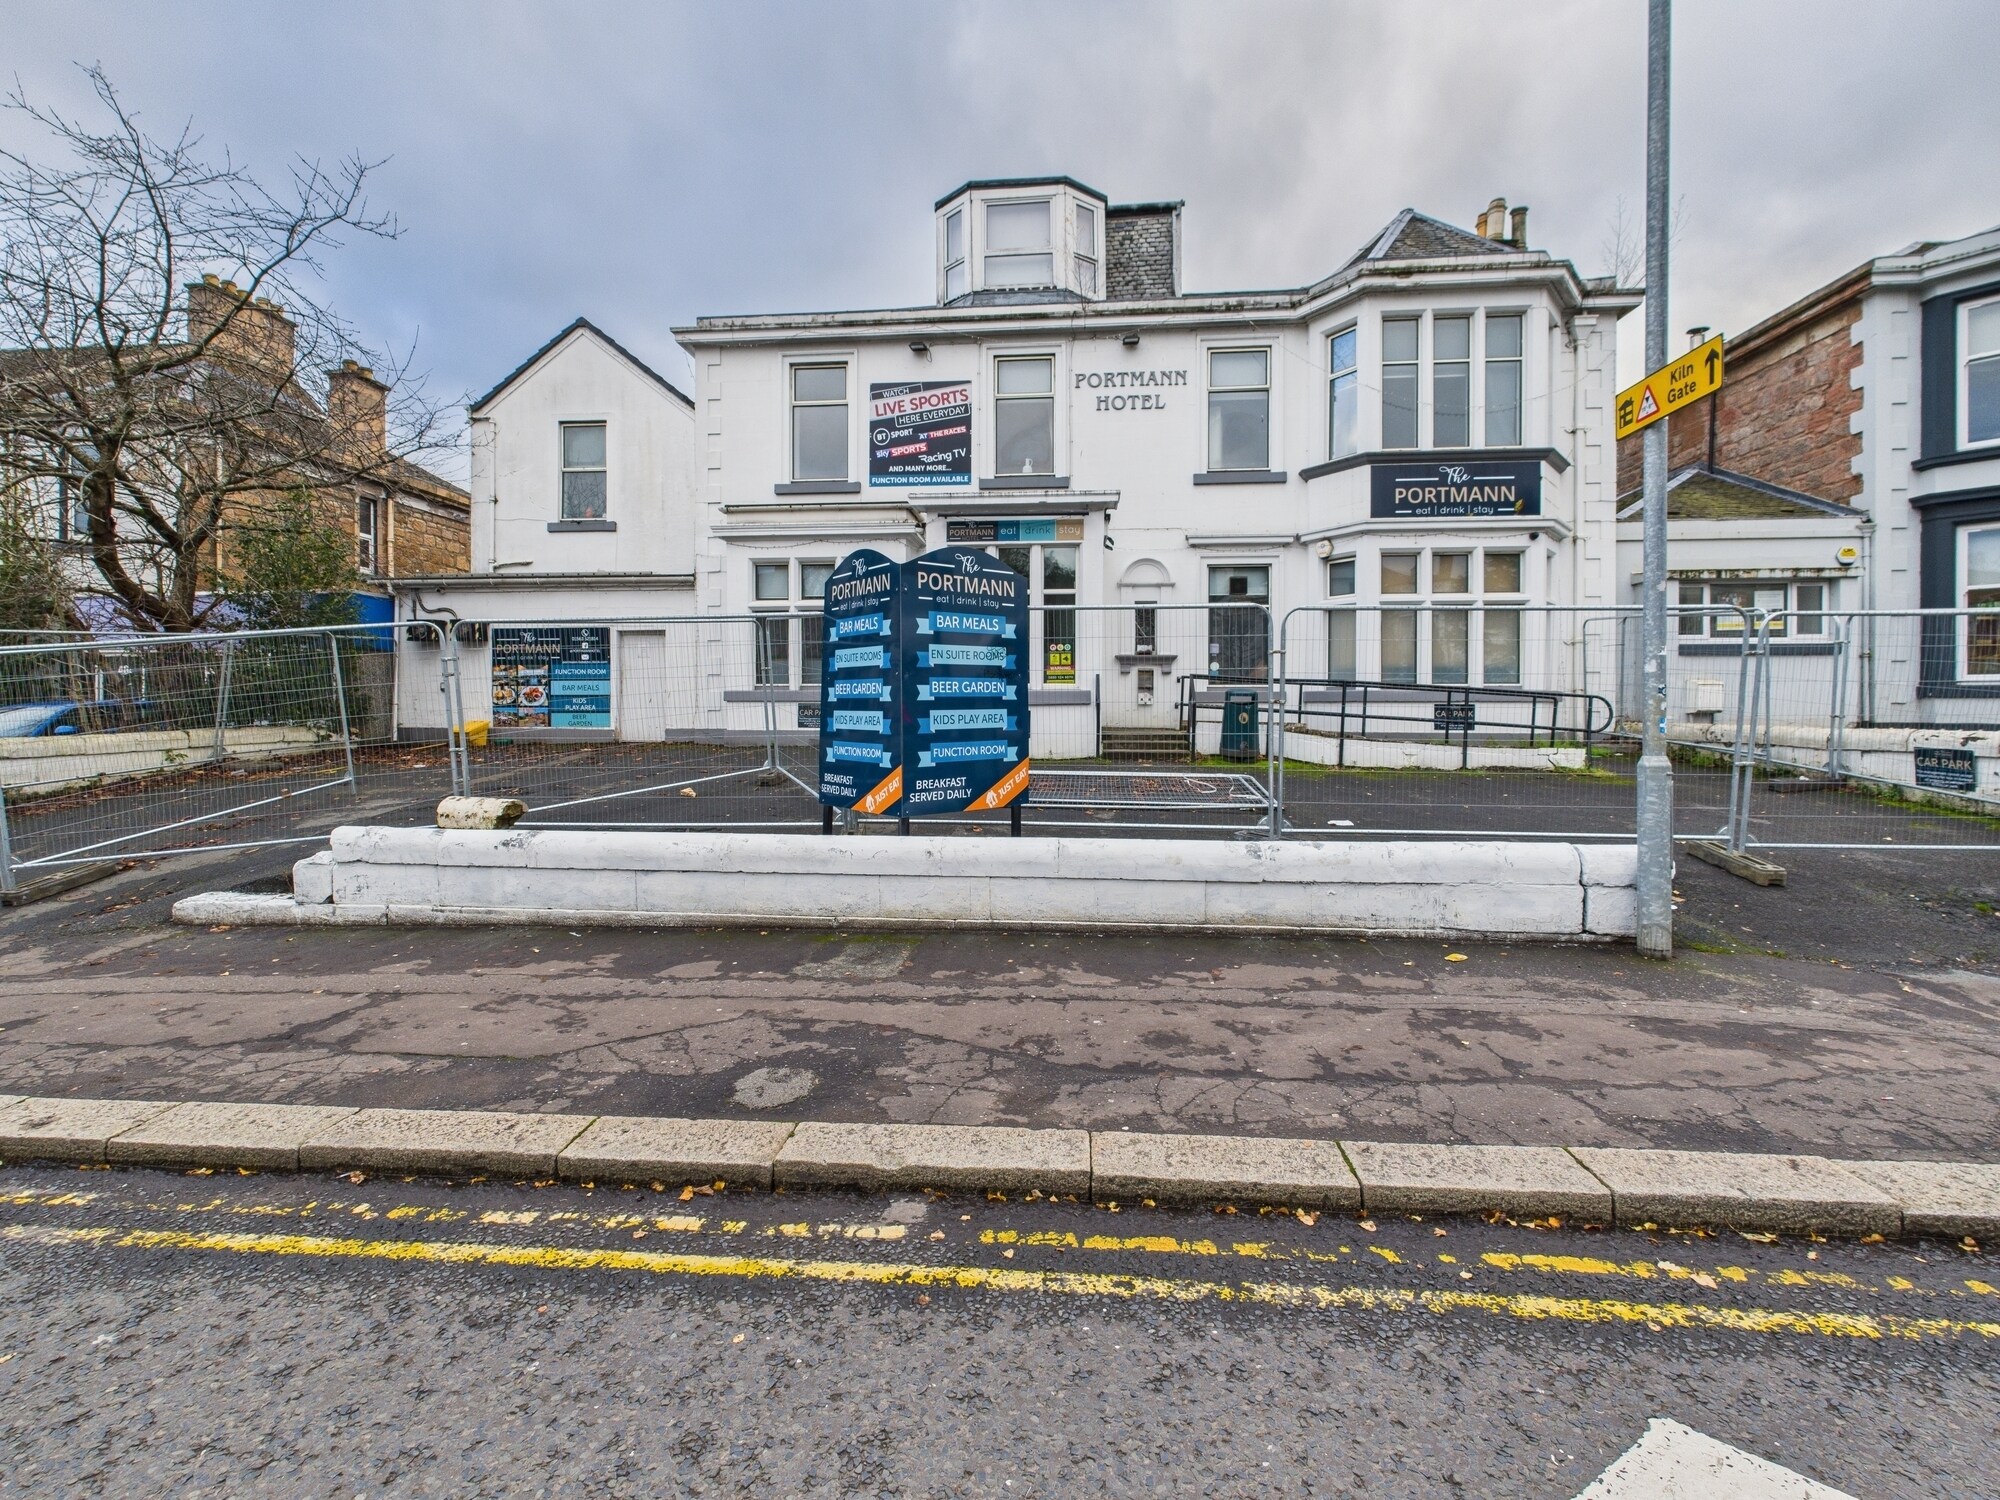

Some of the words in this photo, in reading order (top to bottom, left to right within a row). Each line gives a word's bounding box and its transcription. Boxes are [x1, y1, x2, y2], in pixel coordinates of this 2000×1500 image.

[1074, 370, 1187, 389] PORTMANN
[1670, 364, 1694, 385] Kiln
[882, 387, 910, 399] WATCH
[1667, 381, 1696, 404] Gate
[875, 400, 906, 417] LIVE
[910, 388, 969, 411] SPORTS
[1096, 394, 1166, 411] HOTEL
[898, 414, 922, 425] HERE
[923, 406, 966, 421] EVERYDAY
[877, 432, 887, 441] BT
[890, 428, 914, 438] SPORT
[918, 432, 928, 440] AT
[929, 429, 943, 438] THE
[943, 426, 967, 435] RACES
[875, 449, 890, 459] sky
[891, 442, 927, 457] SPORTS
[918, 451, 952, 463] Racing
[952, 448, 967, 458] TV
[932, 475, 969, 483] AVAILABLE
[1438, 466, 1472, 485] The
[1395, 485, 1516, 504] PORTMANN
[1415, 506, 1431, 515] eat
[1439, 505, 1465, 514] drink
[1472, 505, 1494, 515] stay
[949, 528, 994, 537] PORTMANN
[1000, 526, 1017, 535] eat
[1024, 525, 1051, 535] drink
[1058, 525, 1081, 536] stay
[851, 558, 868, 579] The
[954, 553, 981, 574] The
[831, 572, 891, 602] PORTMANN
[917, 571, 1015, 598] PORTMANN
[839, 602, 848, 611] eat
[850, 598, 864, 610] drink
[867, 597, 879, 608] stay
[936, 595, 950, 604] eat
[956, 595, 977, 606] drink
[983, 598, 1000, 610] stay
[839, 621, 853, 634] BAR
[853, 616, 879, 632] MEALS
[936, 615, 960, 629] BAR
[962, 617, 999, 631] MEALS
[496, 643, 560, 654] PORTMANN
[931, 649, 944, 660] EN
[945, 650, 971, 661] SUITE
[973, 650, 1004, 662] ROOMS
[835, 654, 844, 664] EN
[844, 652, 859, 663] SUITE
[860, 650, 882, 662] ROOMS
[835, 682, 851, 695] BEER
[852, 682, 882, 695] GARDEN
[931, 681, 959, 693] BEER
[961, 680, 1006, 693] GARDEN
[834, 713, 848, 725] KIDS
[849, 714, 863, 726] PLAY
[863, 715, 881, 726] AREA
[933, 714, 956, 726] KIDS
[957, 713, 980, 725] PLAY
[981, 712, 1005, 724] AREA
[833, 745, 862, 757] FUNCTION
[862, 746, 882, 758] ROOM
[933, 746, 979, 758] FUNCTION
[979, 745, 1006, 756] ROOM
[1916, 757, 1939, 768] CAR
[1941, 758, 1972, 771] PARK
[823, 773, 854, 785] BREAKFAST
[915, 777, 967, 791] BREAKFAST
[997, 780, 1015, 800] JUST
[1013, 767, 1027, 785] EAT
[821, 784, 840, 796] SERVED
[840, 785, 857, 797] DAILY
[874, 785, 889, 804] JUST
[887, 776, 900, 792] EAT
[909, 790, 945, 803] SERVED
[946, 788, 973, 802] DAILY
